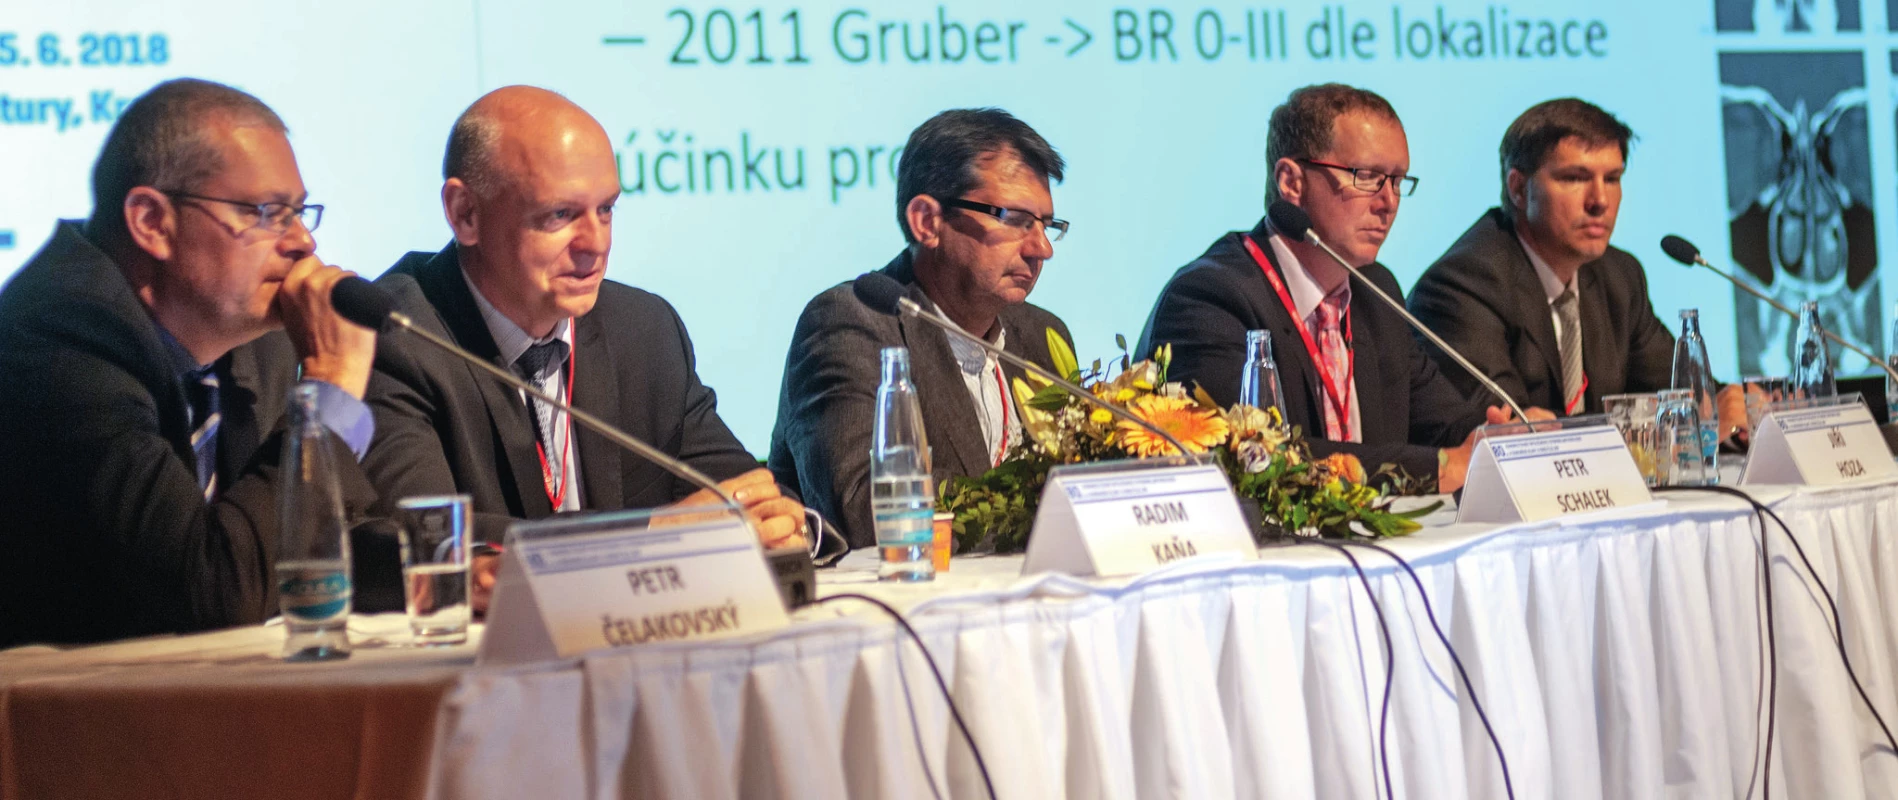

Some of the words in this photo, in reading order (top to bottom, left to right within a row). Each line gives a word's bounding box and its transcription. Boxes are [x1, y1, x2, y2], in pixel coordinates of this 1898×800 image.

[37, 32, 72, 66] 6.
[80, 32, 169, 66] 2018
[666, 8, 810, 65] 2011
[832, 6, 1025, 64] Gruber
[1114, 9, 1178, 61] BR
[1306, 6, 1376, 60] dle
[1393, 6, 1608, 60] lokalizace
[0, 93, 83, 132] tury,
[616, 129, 806, 193] účinku
[1554, 457, 1589, 478] PETR
[1836, 458, 1867, 478] HOZA
[1132, 501, 1189, 526] RADIM
[1556, 488, 1615, 513] SCHALEK
[1151, 536, 1198, 565] KAŇA
[626, 564, 686, 596] PETR
[602, 597, 741, 648] ČELAKOVSKÝ
